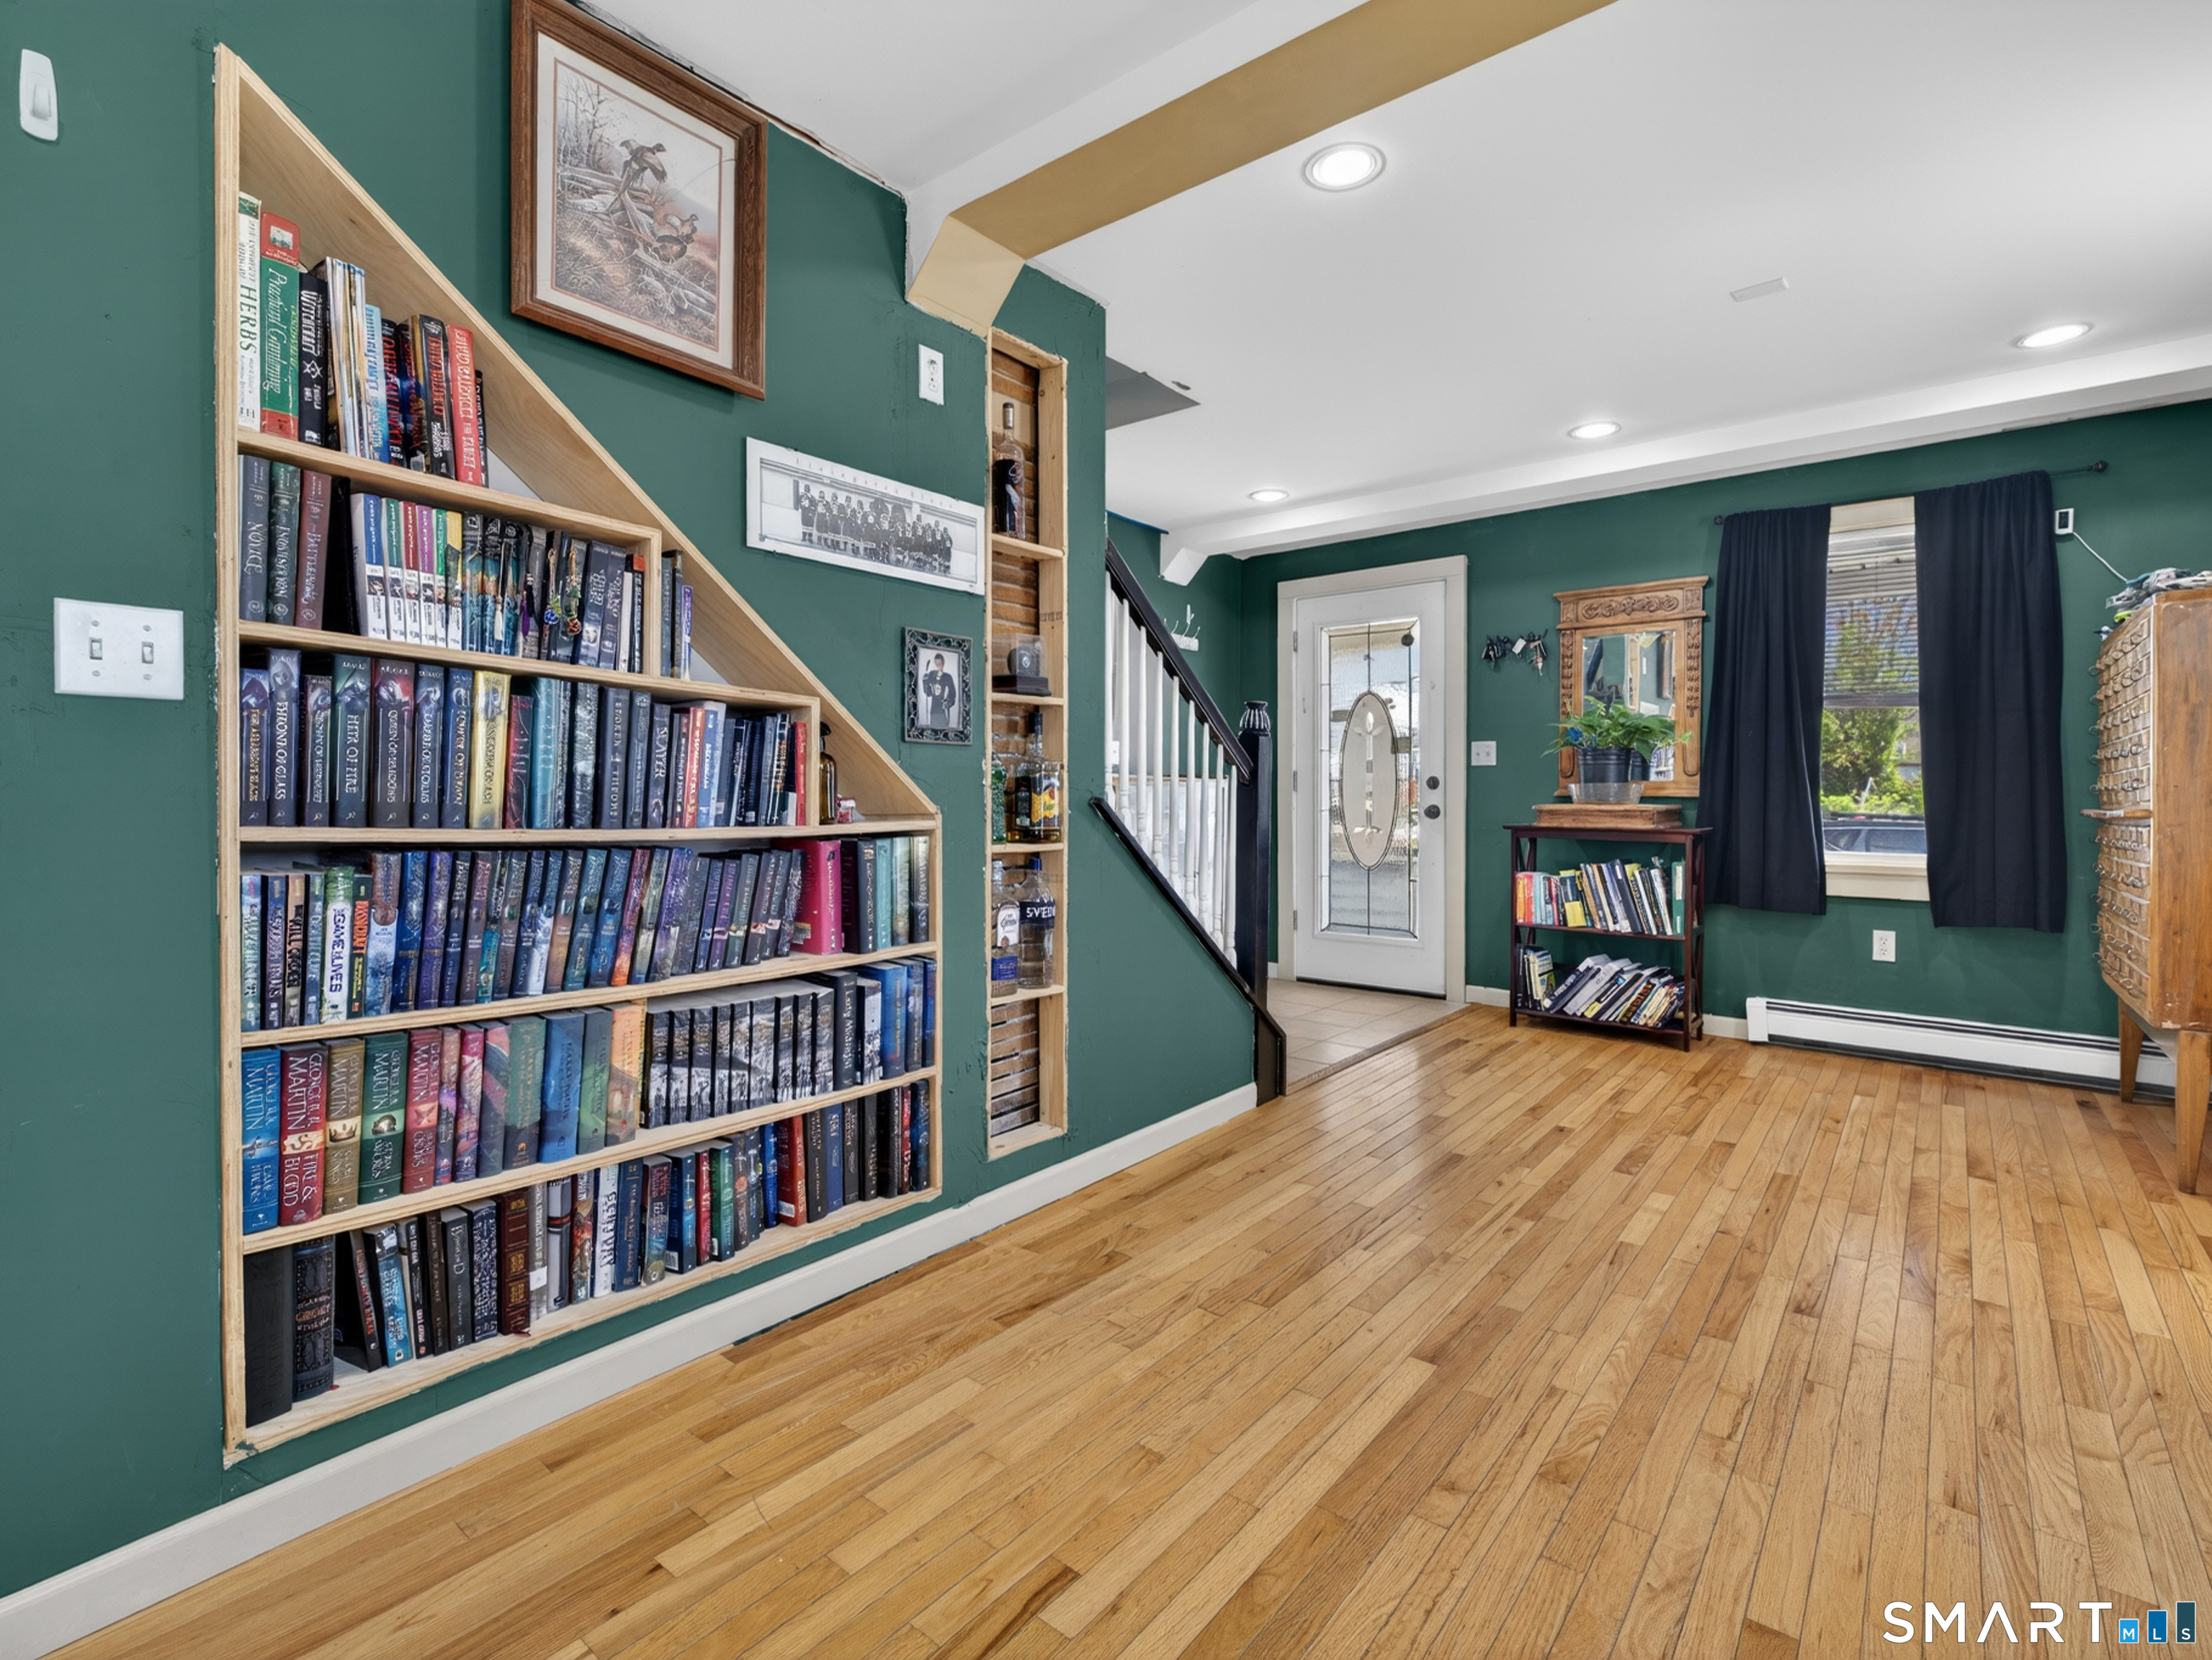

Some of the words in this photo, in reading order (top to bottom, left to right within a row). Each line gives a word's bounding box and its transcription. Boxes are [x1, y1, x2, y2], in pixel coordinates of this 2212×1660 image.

[240, 285, 257, 354] HERBS
[654, 726, 669, 779] SLAYER
[1026, 906, 1056, 918] SVED
[287, 1056, 308, 1130] MARTIN
[284, 1156, 302, 1207] BLOOD
[301, 1185, 318, 1203] &
